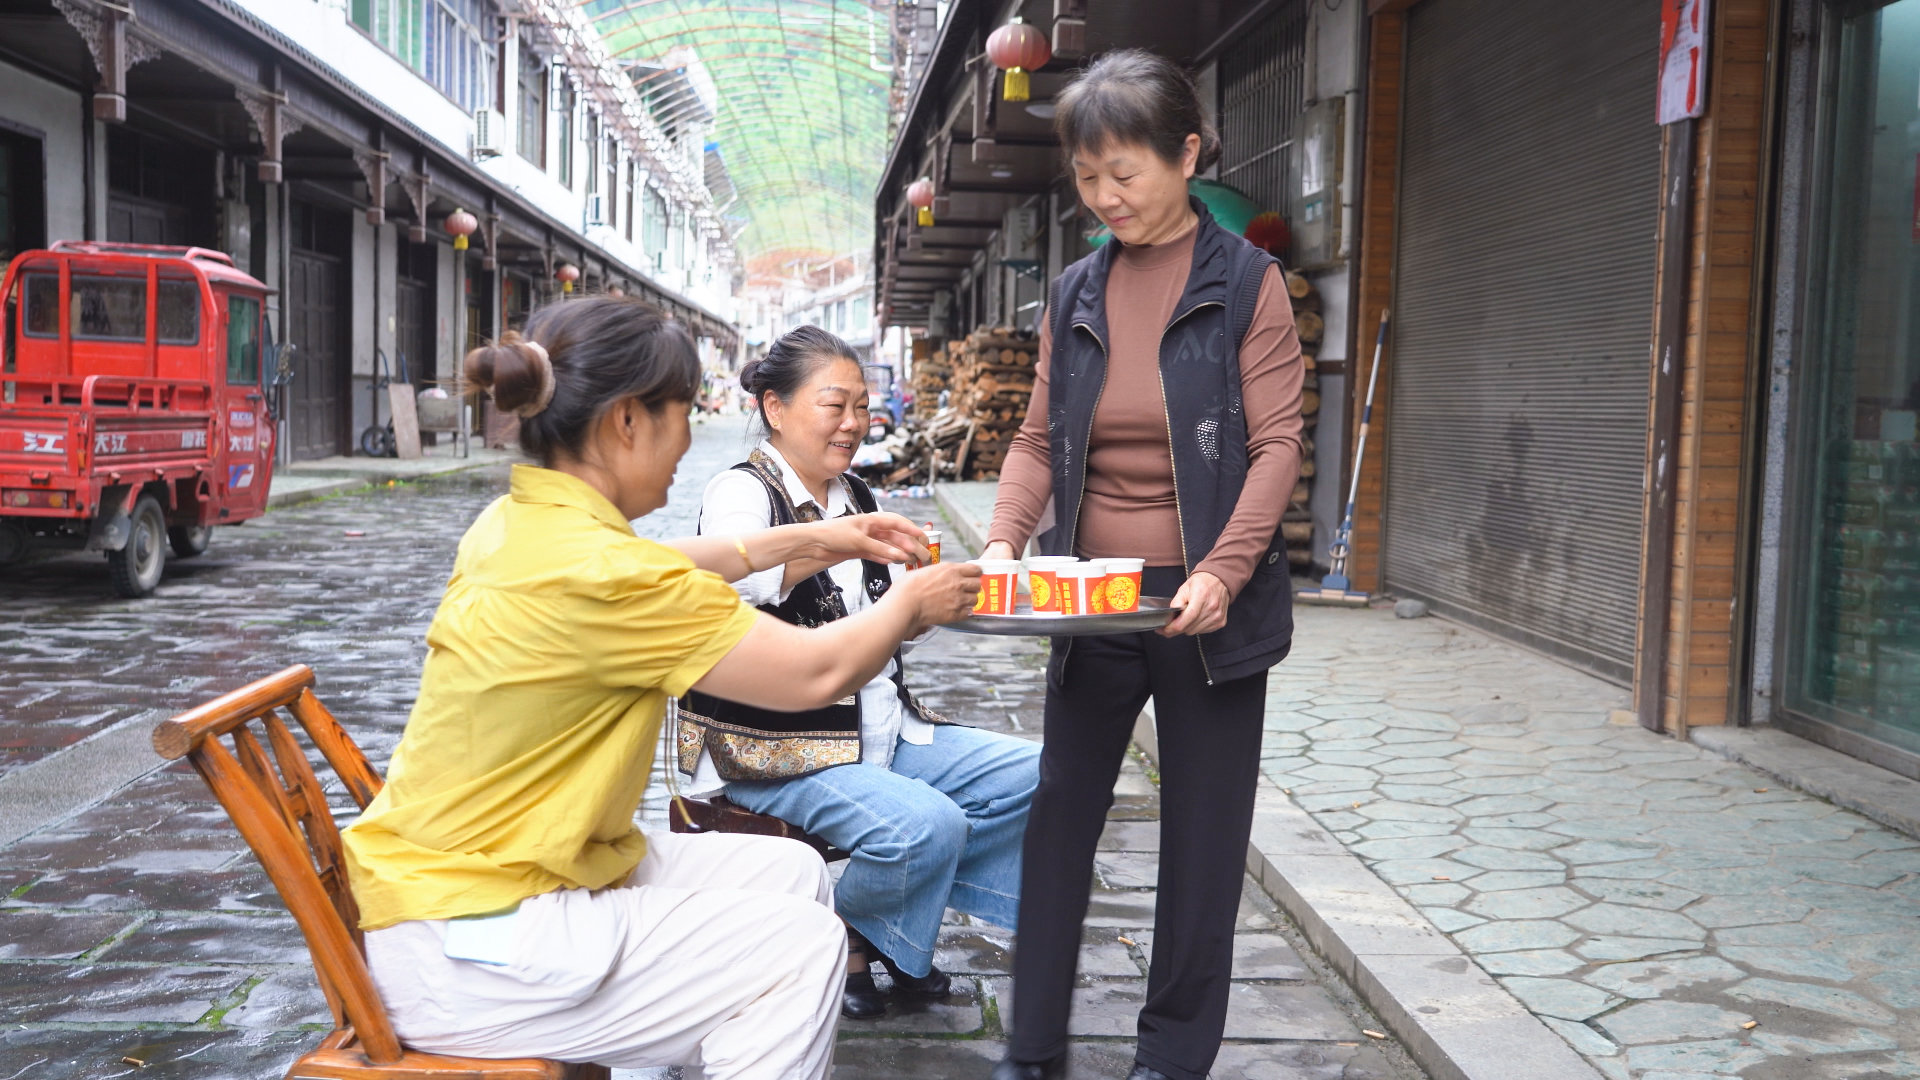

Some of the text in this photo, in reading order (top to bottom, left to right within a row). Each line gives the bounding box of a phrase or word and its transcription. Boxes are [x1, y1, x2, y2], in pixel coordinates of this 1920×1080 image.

[23, 431, 65, 454] 江
[94, 433, 127, 453] 大江
[229, 435, 255, 452] 大江
